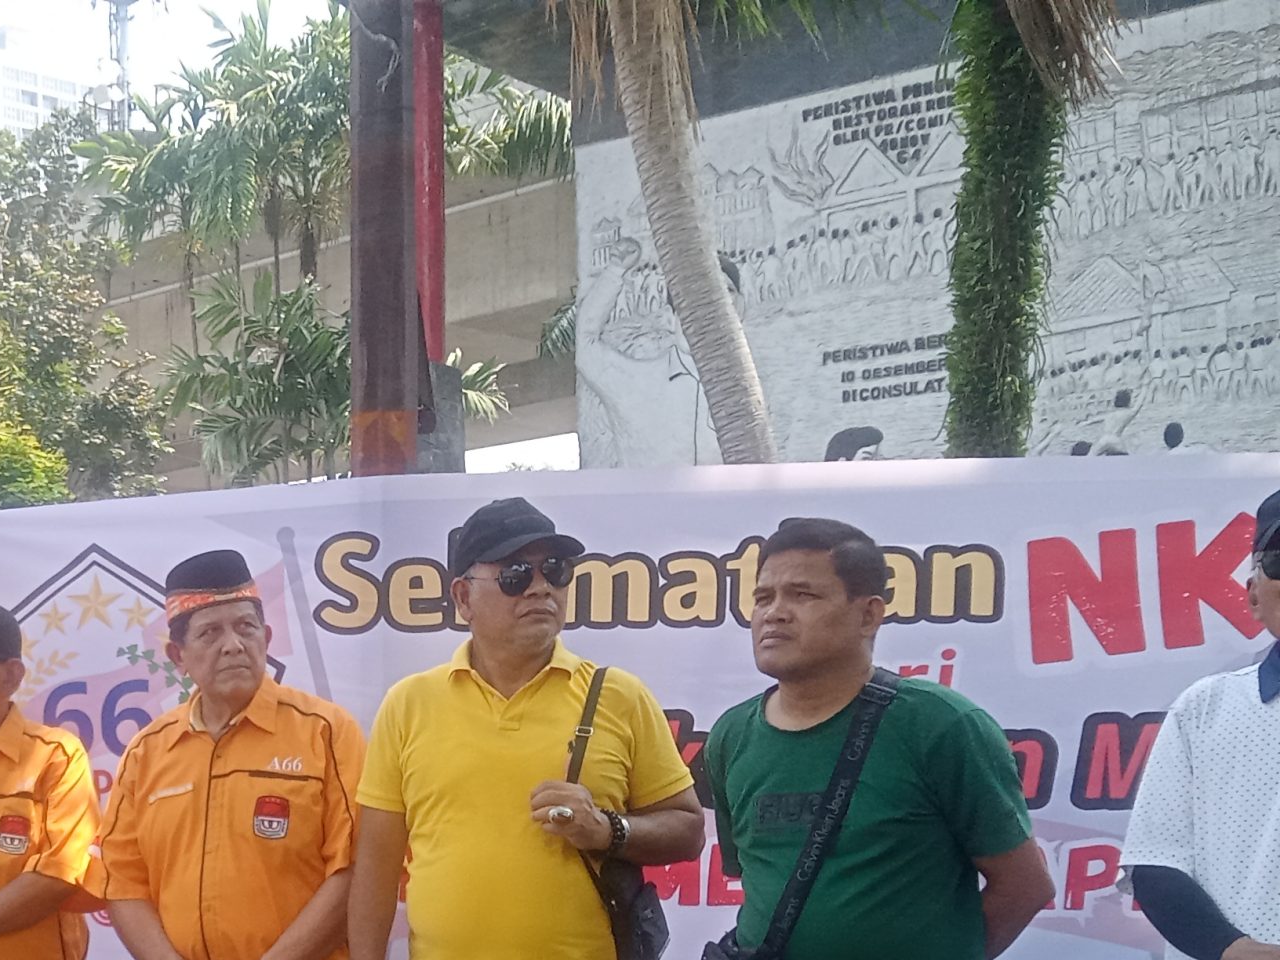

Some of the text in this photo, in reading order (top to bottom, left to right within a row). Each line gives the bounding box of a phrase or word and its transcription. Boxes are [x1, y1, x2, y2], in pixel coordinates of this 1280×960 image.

[802, 89, 897, 122] PERISTIWA
[832, 101, 921, 131] RESTORAN
[822, 339, 911, 366] PERISTIWA
[841, 370, 855, 383] 10
[268, 756, 303, 772] A66
